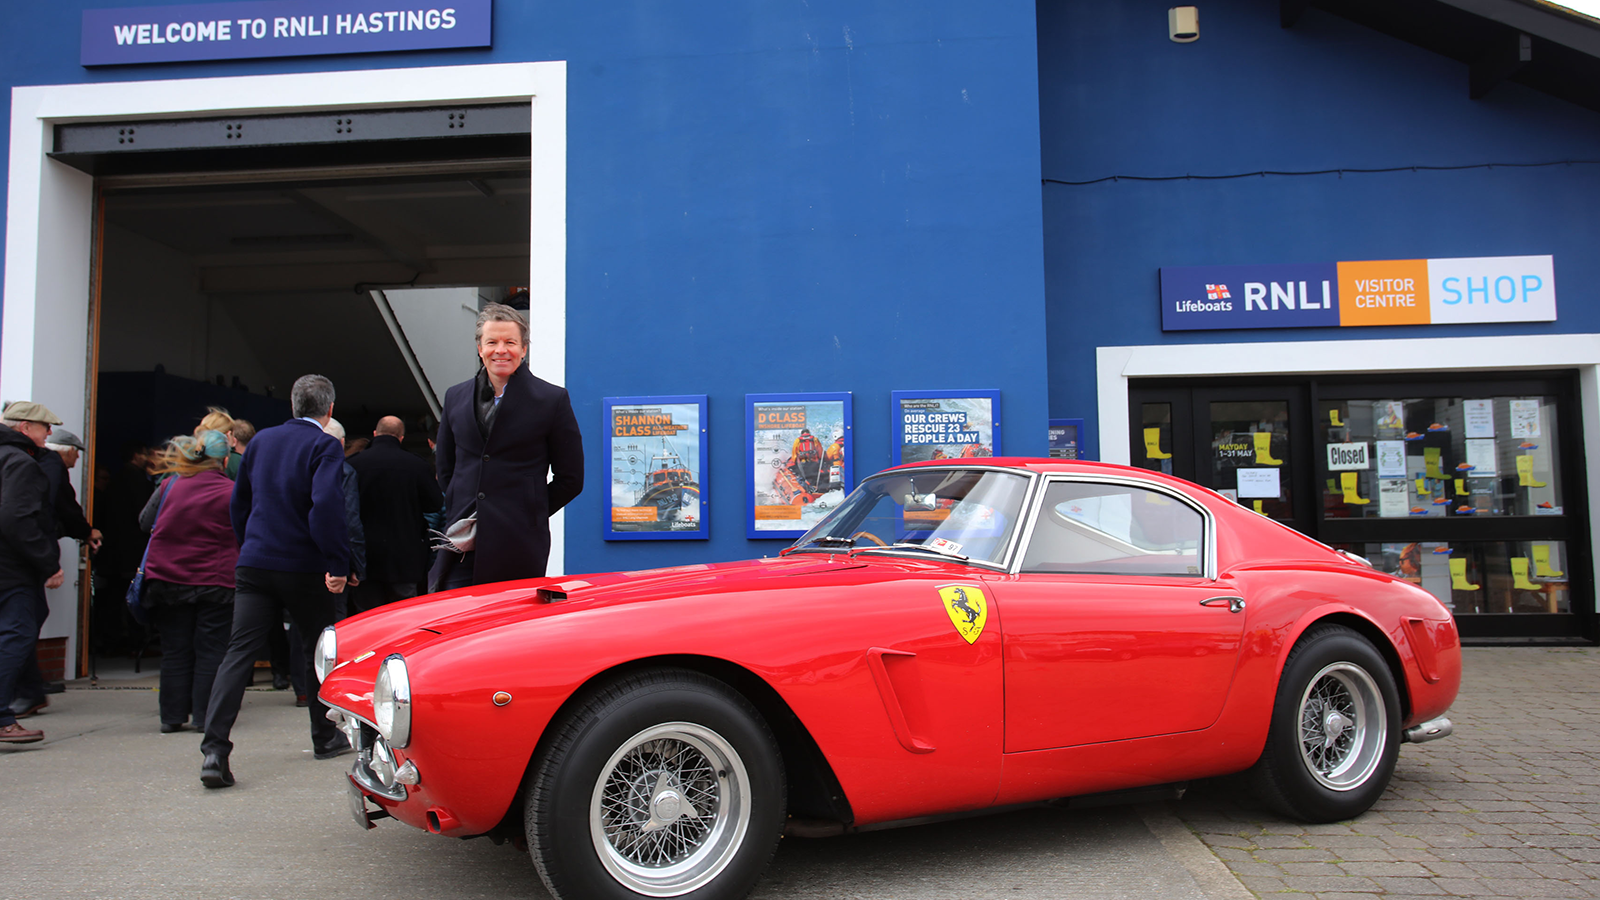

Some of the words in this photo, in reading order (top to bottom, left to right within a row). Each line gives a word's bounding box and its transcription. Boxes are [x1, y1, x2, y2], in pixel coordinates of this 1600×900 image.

[114, 20, 231, 46] WELCOME
[238, 18, 267, 40] TO
[274, 15, 328, 38] RNLI
[336, 8, 456, 36] HASTINGS
[1354, 278, 1414, 293] VISITOR
[1441, 274, 1543, 306] SHOP
[1244, 280, 1331, 311] RNLI
[1355, 294, 1416, 308] CENTRE
[1176, 300, 1232, 312] Lifeboats
[615, 414, 671, 425] SHANNON
[758, 413, 766, 423] D
[769, 413, 805, 422] CLASS
[904, 414, 926, 423] OUR
[928, 413, 965, 423] CREWS
[615, 426, 651, 436] CLASS
[905, 424, 946, 433] RESCUE
[948, 424, 960, 433] 23
[905, 434, 946, 443] PEOPLE
[947, 434, 955, 443] A
[957, 433, 978, 442] DAY
[1331, 446, 1365, 465] Closed
